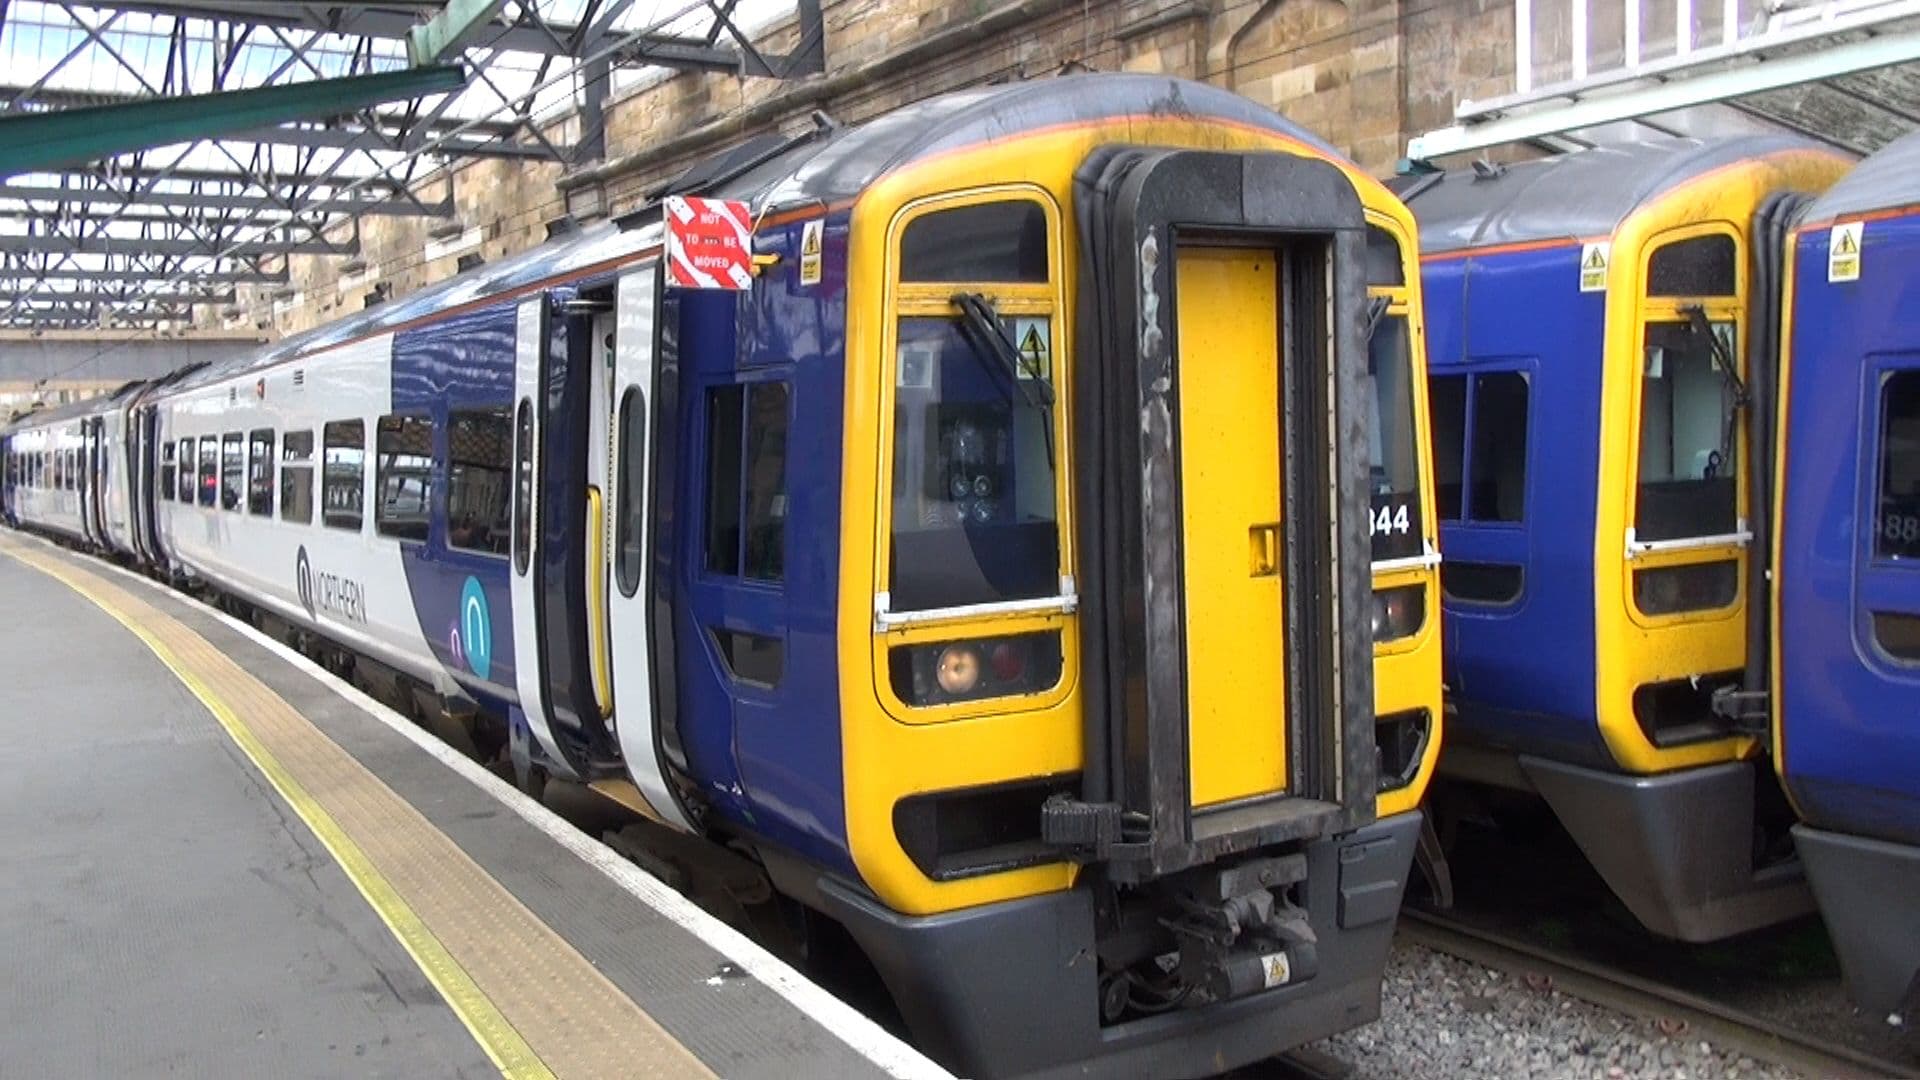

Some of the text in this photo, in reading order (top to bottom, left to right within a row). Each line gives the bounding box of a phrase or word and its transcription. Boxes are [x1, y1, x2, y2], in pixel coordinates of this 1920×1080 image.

[701, 213, 720, 225] NOT
[685, 233, 699, 245] TO
[723, 236, 737, 249] BE
[694, 256, 729, 269] MOVED
[312, 569, 368, 625] NORTHERN
